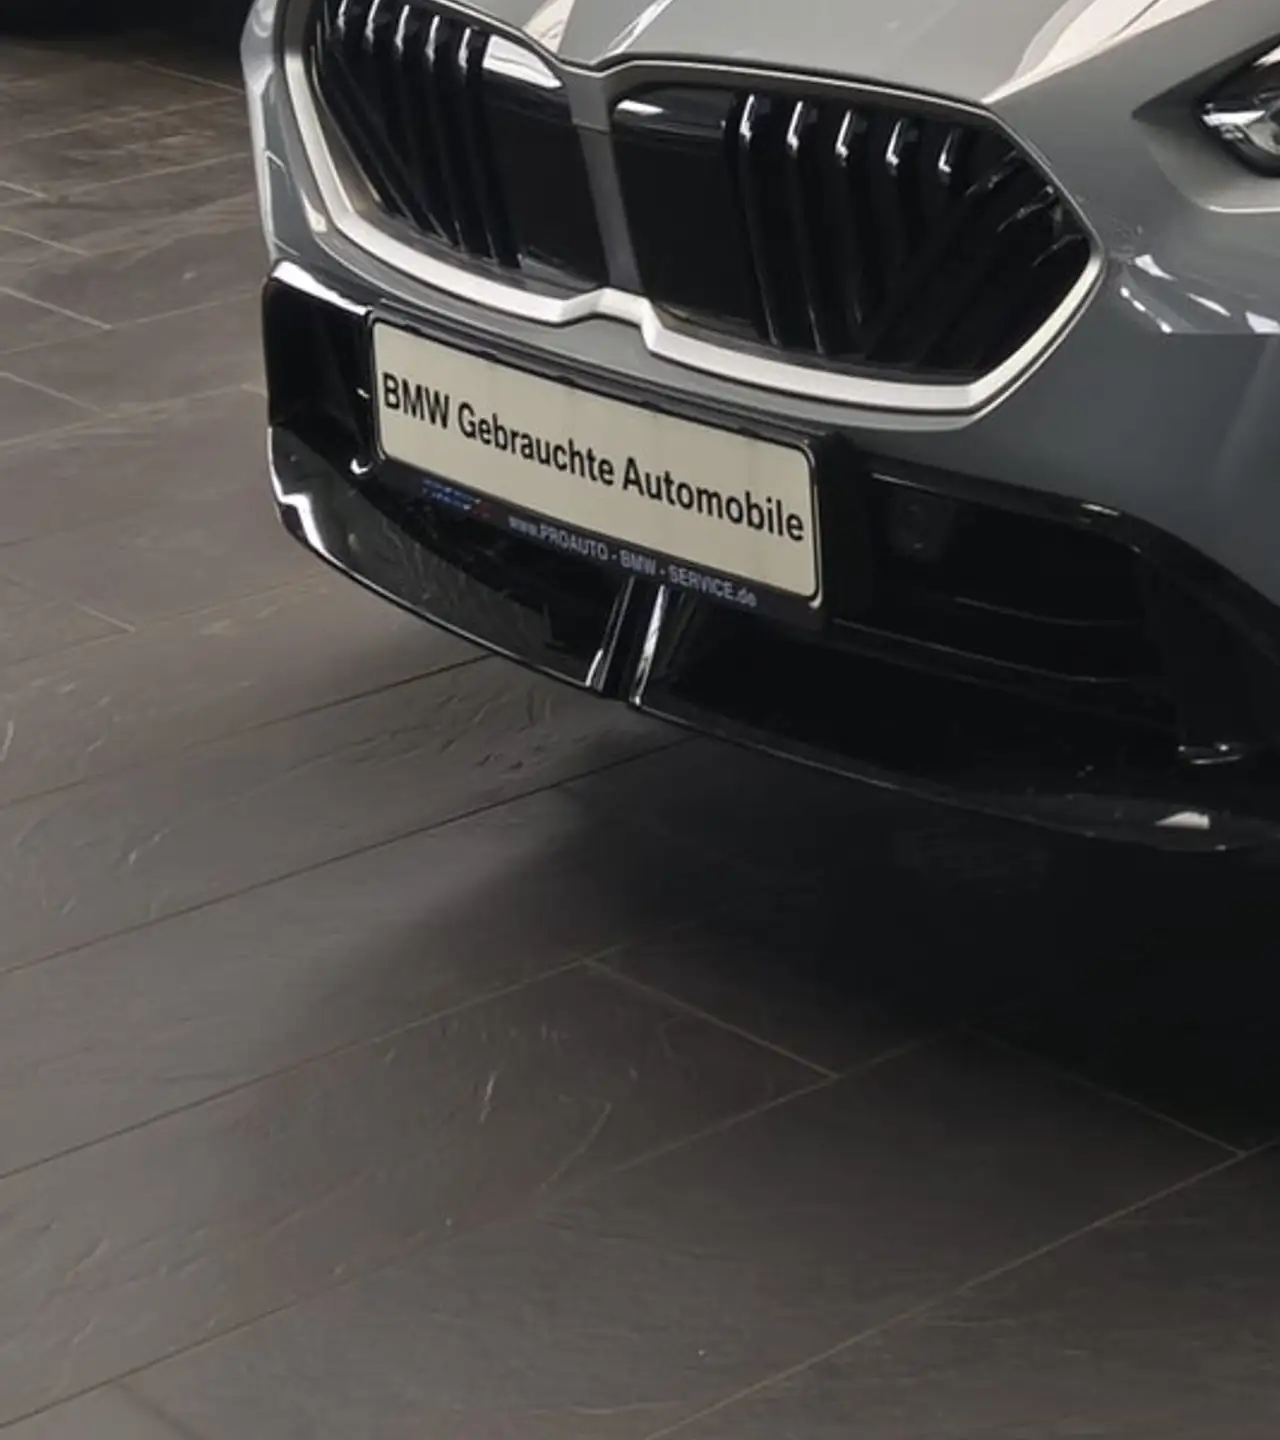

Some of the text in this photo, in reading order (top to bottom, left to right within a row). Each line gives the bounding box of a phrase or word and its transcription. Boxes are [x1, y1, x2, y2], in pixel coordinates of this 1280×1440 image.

[382, 372, 804, 542] BMW Gebrauchte Automobile
[619, 549, 656, 577] BMW
